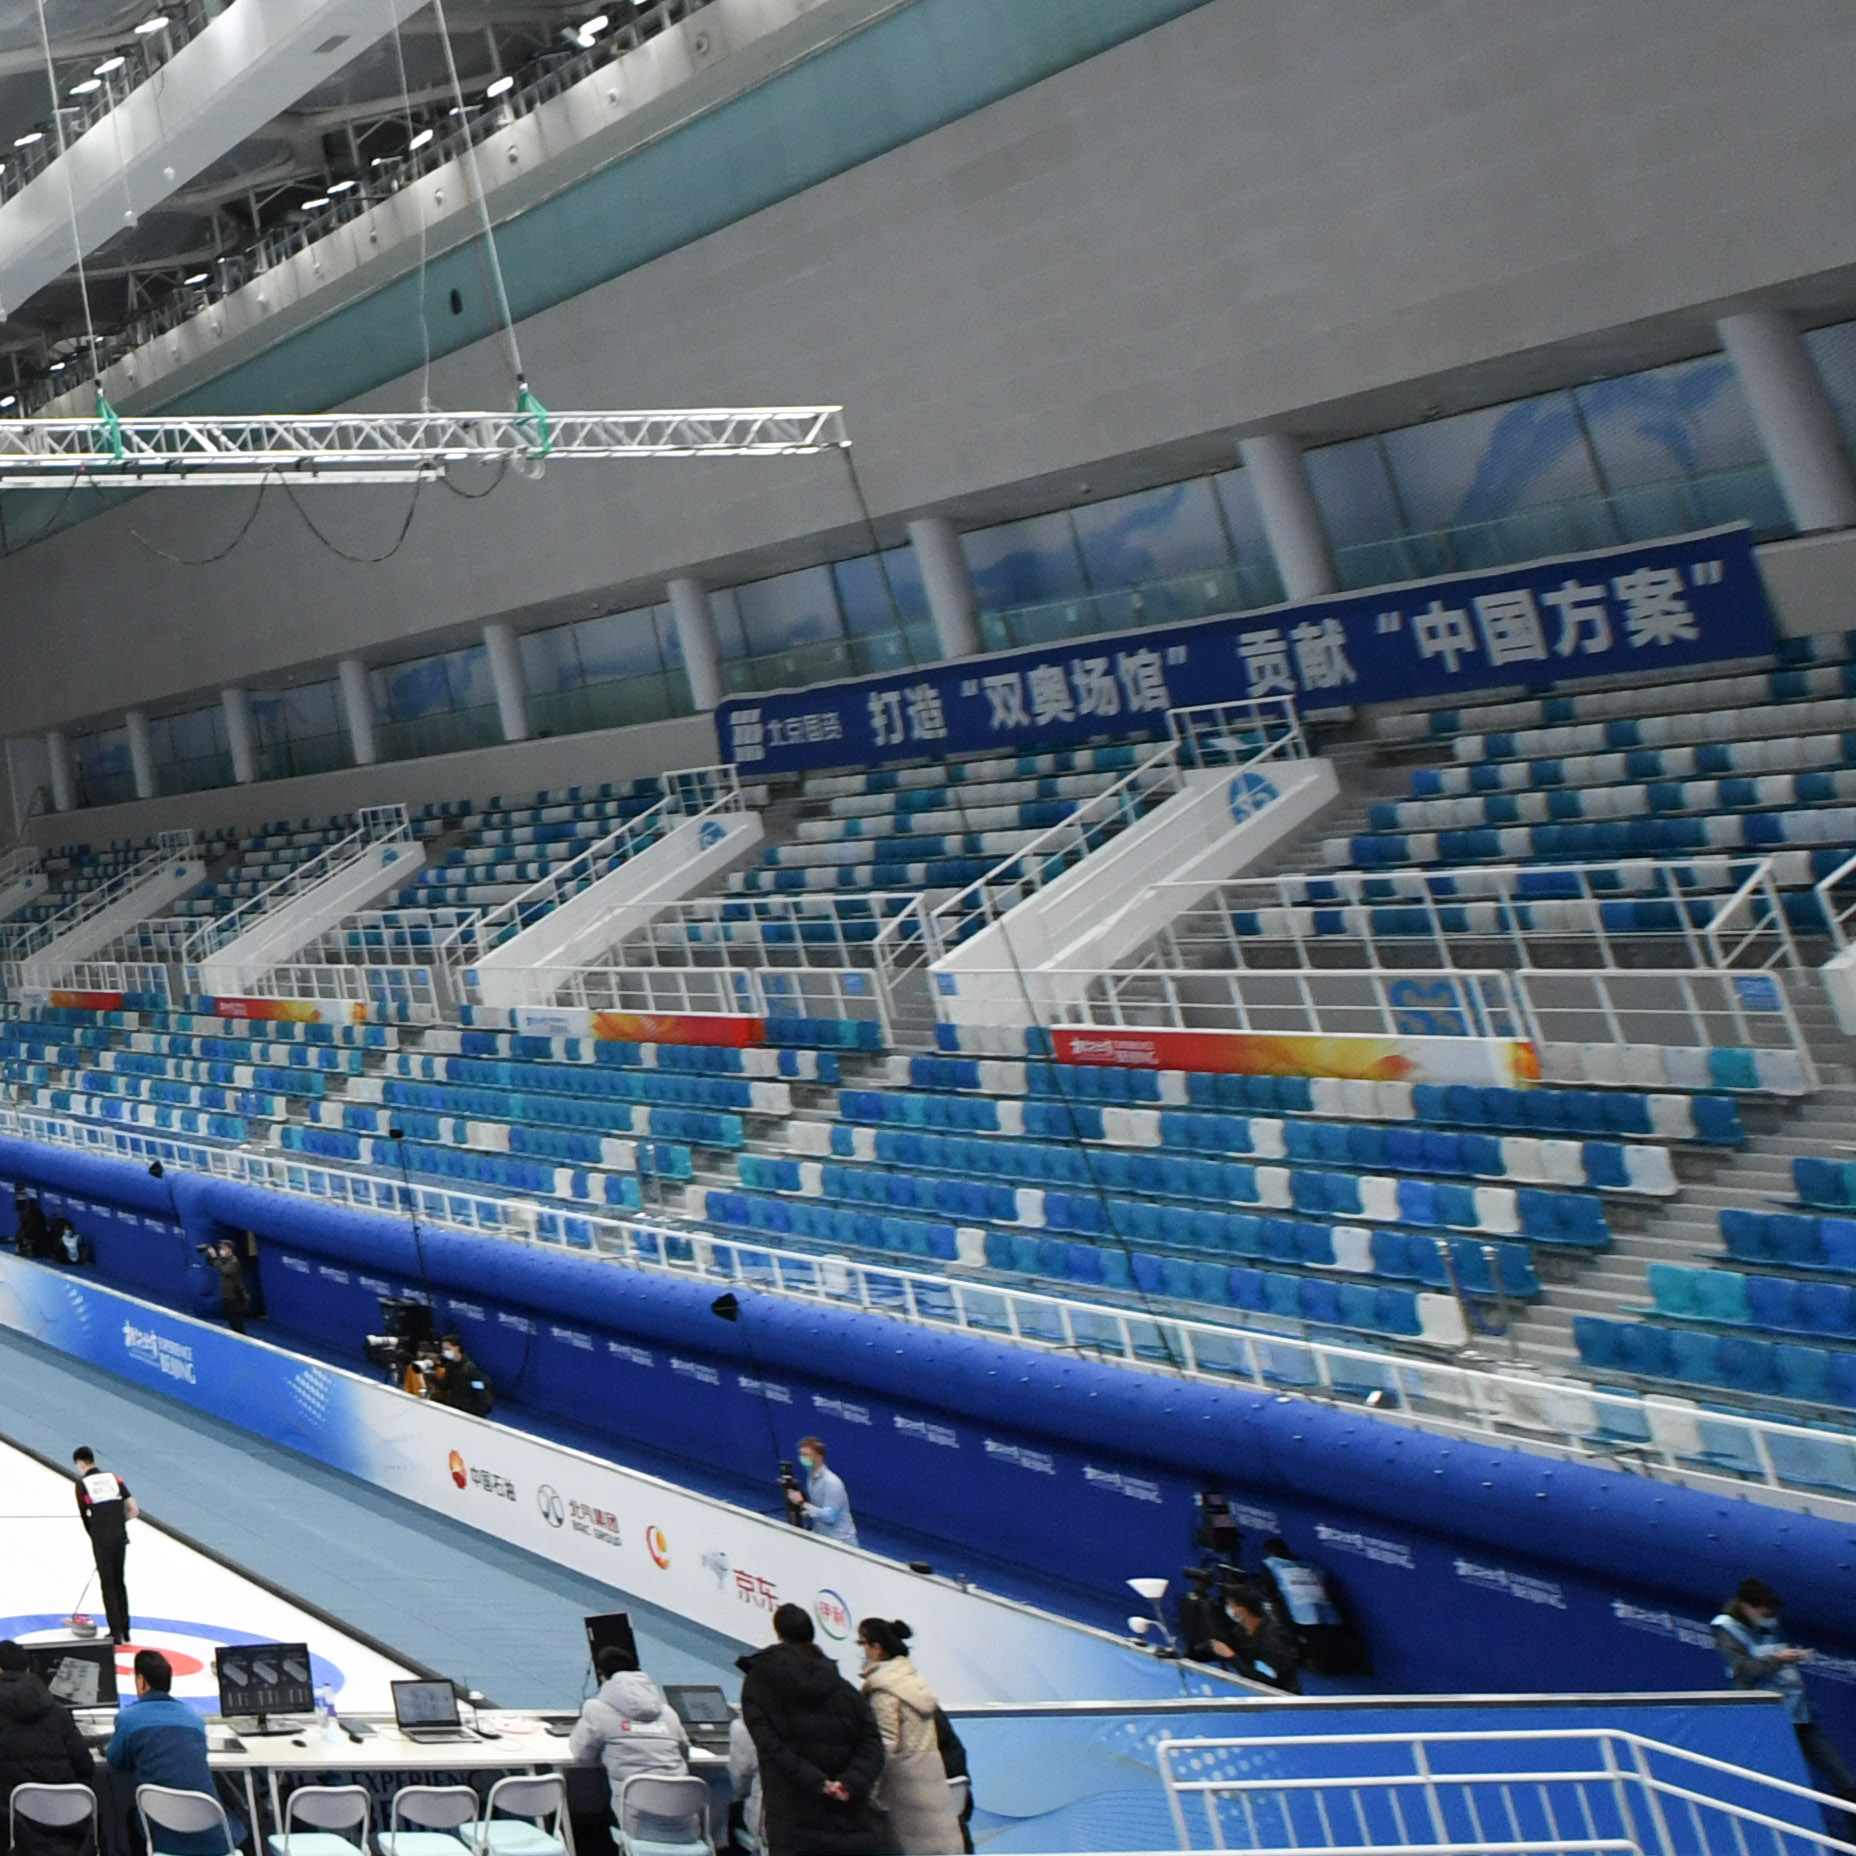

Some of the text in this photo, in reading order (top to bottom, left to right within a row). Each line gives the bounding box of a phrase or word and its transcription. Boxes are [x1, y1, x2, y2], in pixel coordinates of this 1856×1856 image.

[868, 683, 948, 747] 打造
[1237, 617, 1357, 698] 贡献
[732, 1569, 781, 1613] 京东
